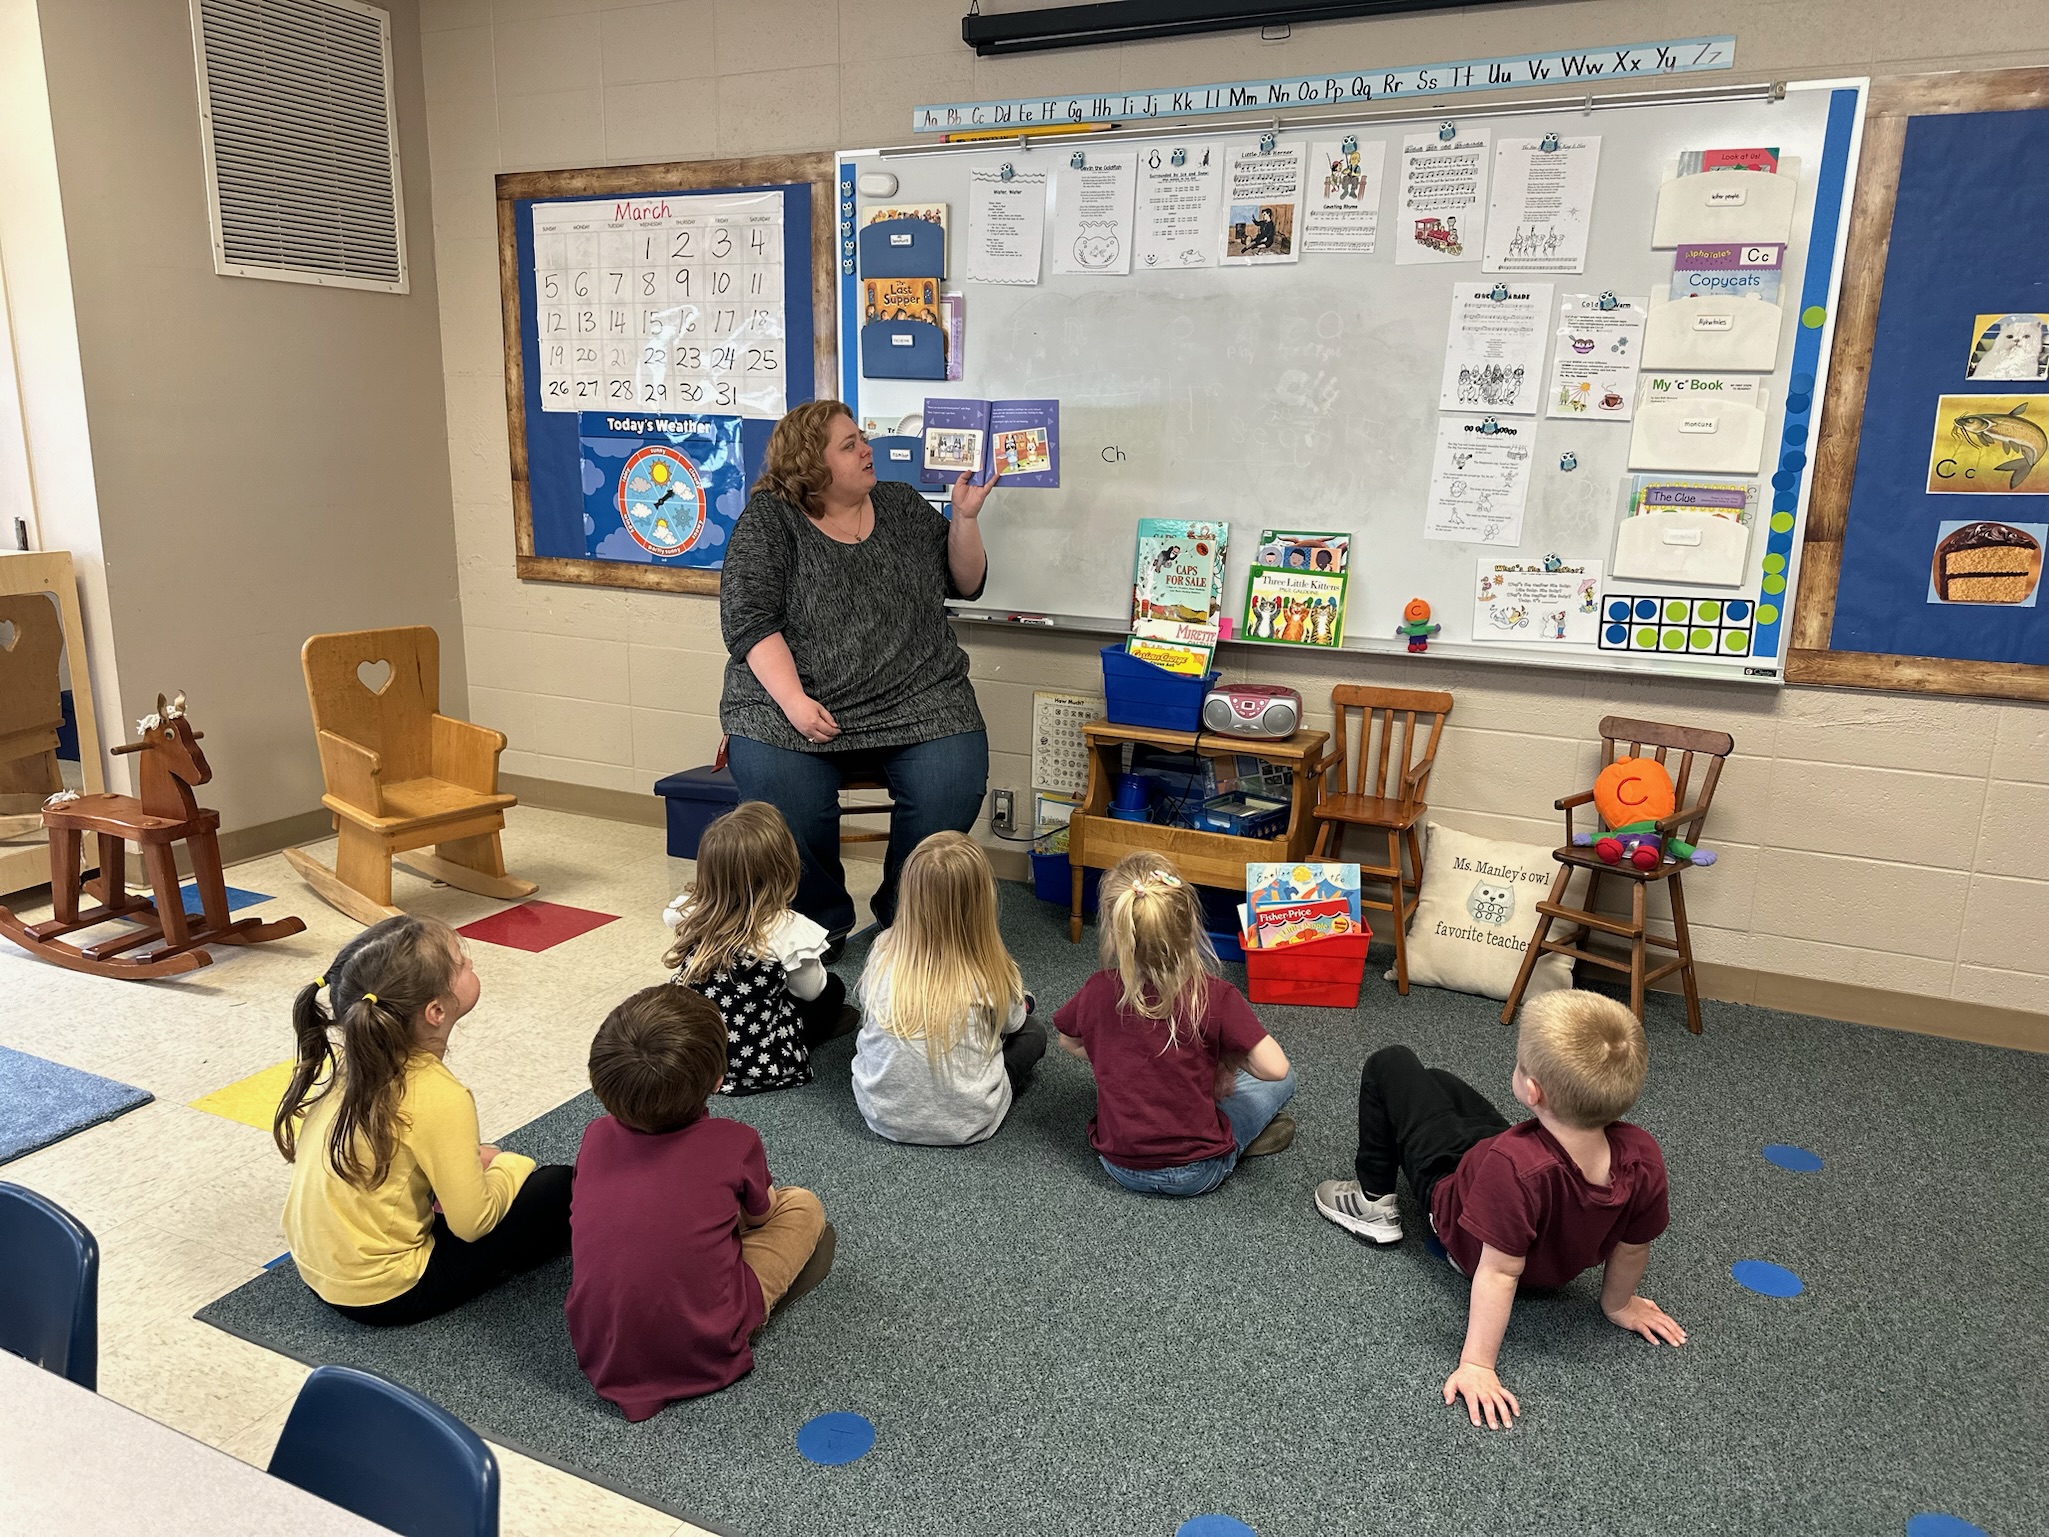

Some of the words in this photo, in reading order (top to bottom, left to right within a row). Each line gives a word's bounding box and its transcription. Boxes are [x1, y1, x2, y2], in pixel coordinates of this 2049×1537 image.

[924, 110, 938, 127] Aa
[948, 109, 961, 125] Bb
[973, 106, 984, 124] Cc
[995, 105, 1010, 123] Dd
[1019, 104, 1033, 121] Ee
[1042, 102, 1056, 119] Ff
[1068, 101, 1082, 122] Gg
[1093, 98, 1111, 117] Hh
[1143, 95, 1156, 117] Jj
[1173, 92, 1192, 111] Kk
[1230, 87, 1257, 107] Mm
[1269, 84, 1290, 103] Nn
[1299, 82, 1318, 100] Oo
[1325, 78, 1344, 103] Pp
[1352, 76, 1372, 100] Qq
[1384, 73, 1403, 93] Rr
[1417, 70, 1438, 90] Ss
[1449, 66, 1474, 87] Tt
[1489, 63, 1512, 83] Uu
[1529, 59, 1550, 80] Vv
[1561, 55, 1603, 77] Ww
[1613, 50, 1641, 73] Xx
[1656, 46, 1676, 73] Yy
[614, 201, 671, 222] March
[671, 232, 694, 258] 2
[711, 228, 732, 258] 3
[750, 229, 765, 255] 4
[545, 274, 558, 298] 5
[574, 271, 588, 297] 6
[609, 273, 623, 294] 7
[642, 272, 655, 296] 8
[676, 269, 689, 297] 9
[712, 272, 730, 295] 10
[752, 272, 763, 294] 11
[890, 285, 912, 295] Last
[1689, 273, 1760, 290] Copycats
[884, 294, 920, 306] Supper
[547, 312, 566, 333] 12
[578, 311, 596, 333] 13
[609, 310, 625, 334] 14
[642, 310, 663, 335] 15
[679, 309, 696, 334] 16
[714, 310, 735, 332] 17
[750, 309, 768, 330] 18
[549, 345, 565, 366] 19
[577, 348, 597, 362] 20
[611, 348, 626, 367] 21
[644, 347, 666, 365] 22
[676, 347, 701, 368] 23
[711, 347, 735, 370] 24
[747, 350, 777, 372] 25
[549, 381, 569, 396] 26
[576, 380, 598, 397] 27
[610, 380, 634, 400] 28
[645, 384, 667, 402] 29
[680, 383, 703, 402] 30
[715, 382, 737, 406] 31
[1652, 379, 1671, 392] My
[1690, 379, 1723, 391] Book
[607, 417, 654, 435] Today's
[656, 418, 711, 437] Weather
[650, 447, 667, 455] sunny
[1101, 445, 1127, 463] Ch
[688, 467, 702, 488] cloudy
[1654, 491, 1672, 502] The
[1674, 492, 1697, 504] Clue
[1176, 565, 1198, 576] CAPS
[1494, 564, 1523, 572] What's
[1166, 575, 1184, 585] FOR
[1185, 577, 1207, 588] SALE
[1262, 575, 1285, 587] Three
[1287, 578, 1309, 589] Little
[1310, 580, 1340, 591] Kittens
[1411, 605, 1422, 616] C
[1176, 624, 1217, 642] MIRETTE
[1160, 652, 1189, 665] George
[1617, 777, 1648, 805] C
[1452, 857, 1472, 871] Ms.
[1475, 861, 1526, 883] Manley's
[1528, 872, 1550, 885] owl
[1260, 908, 1312, 922] Fisher-Price
[1434, 920, 1483, 943] favorite
